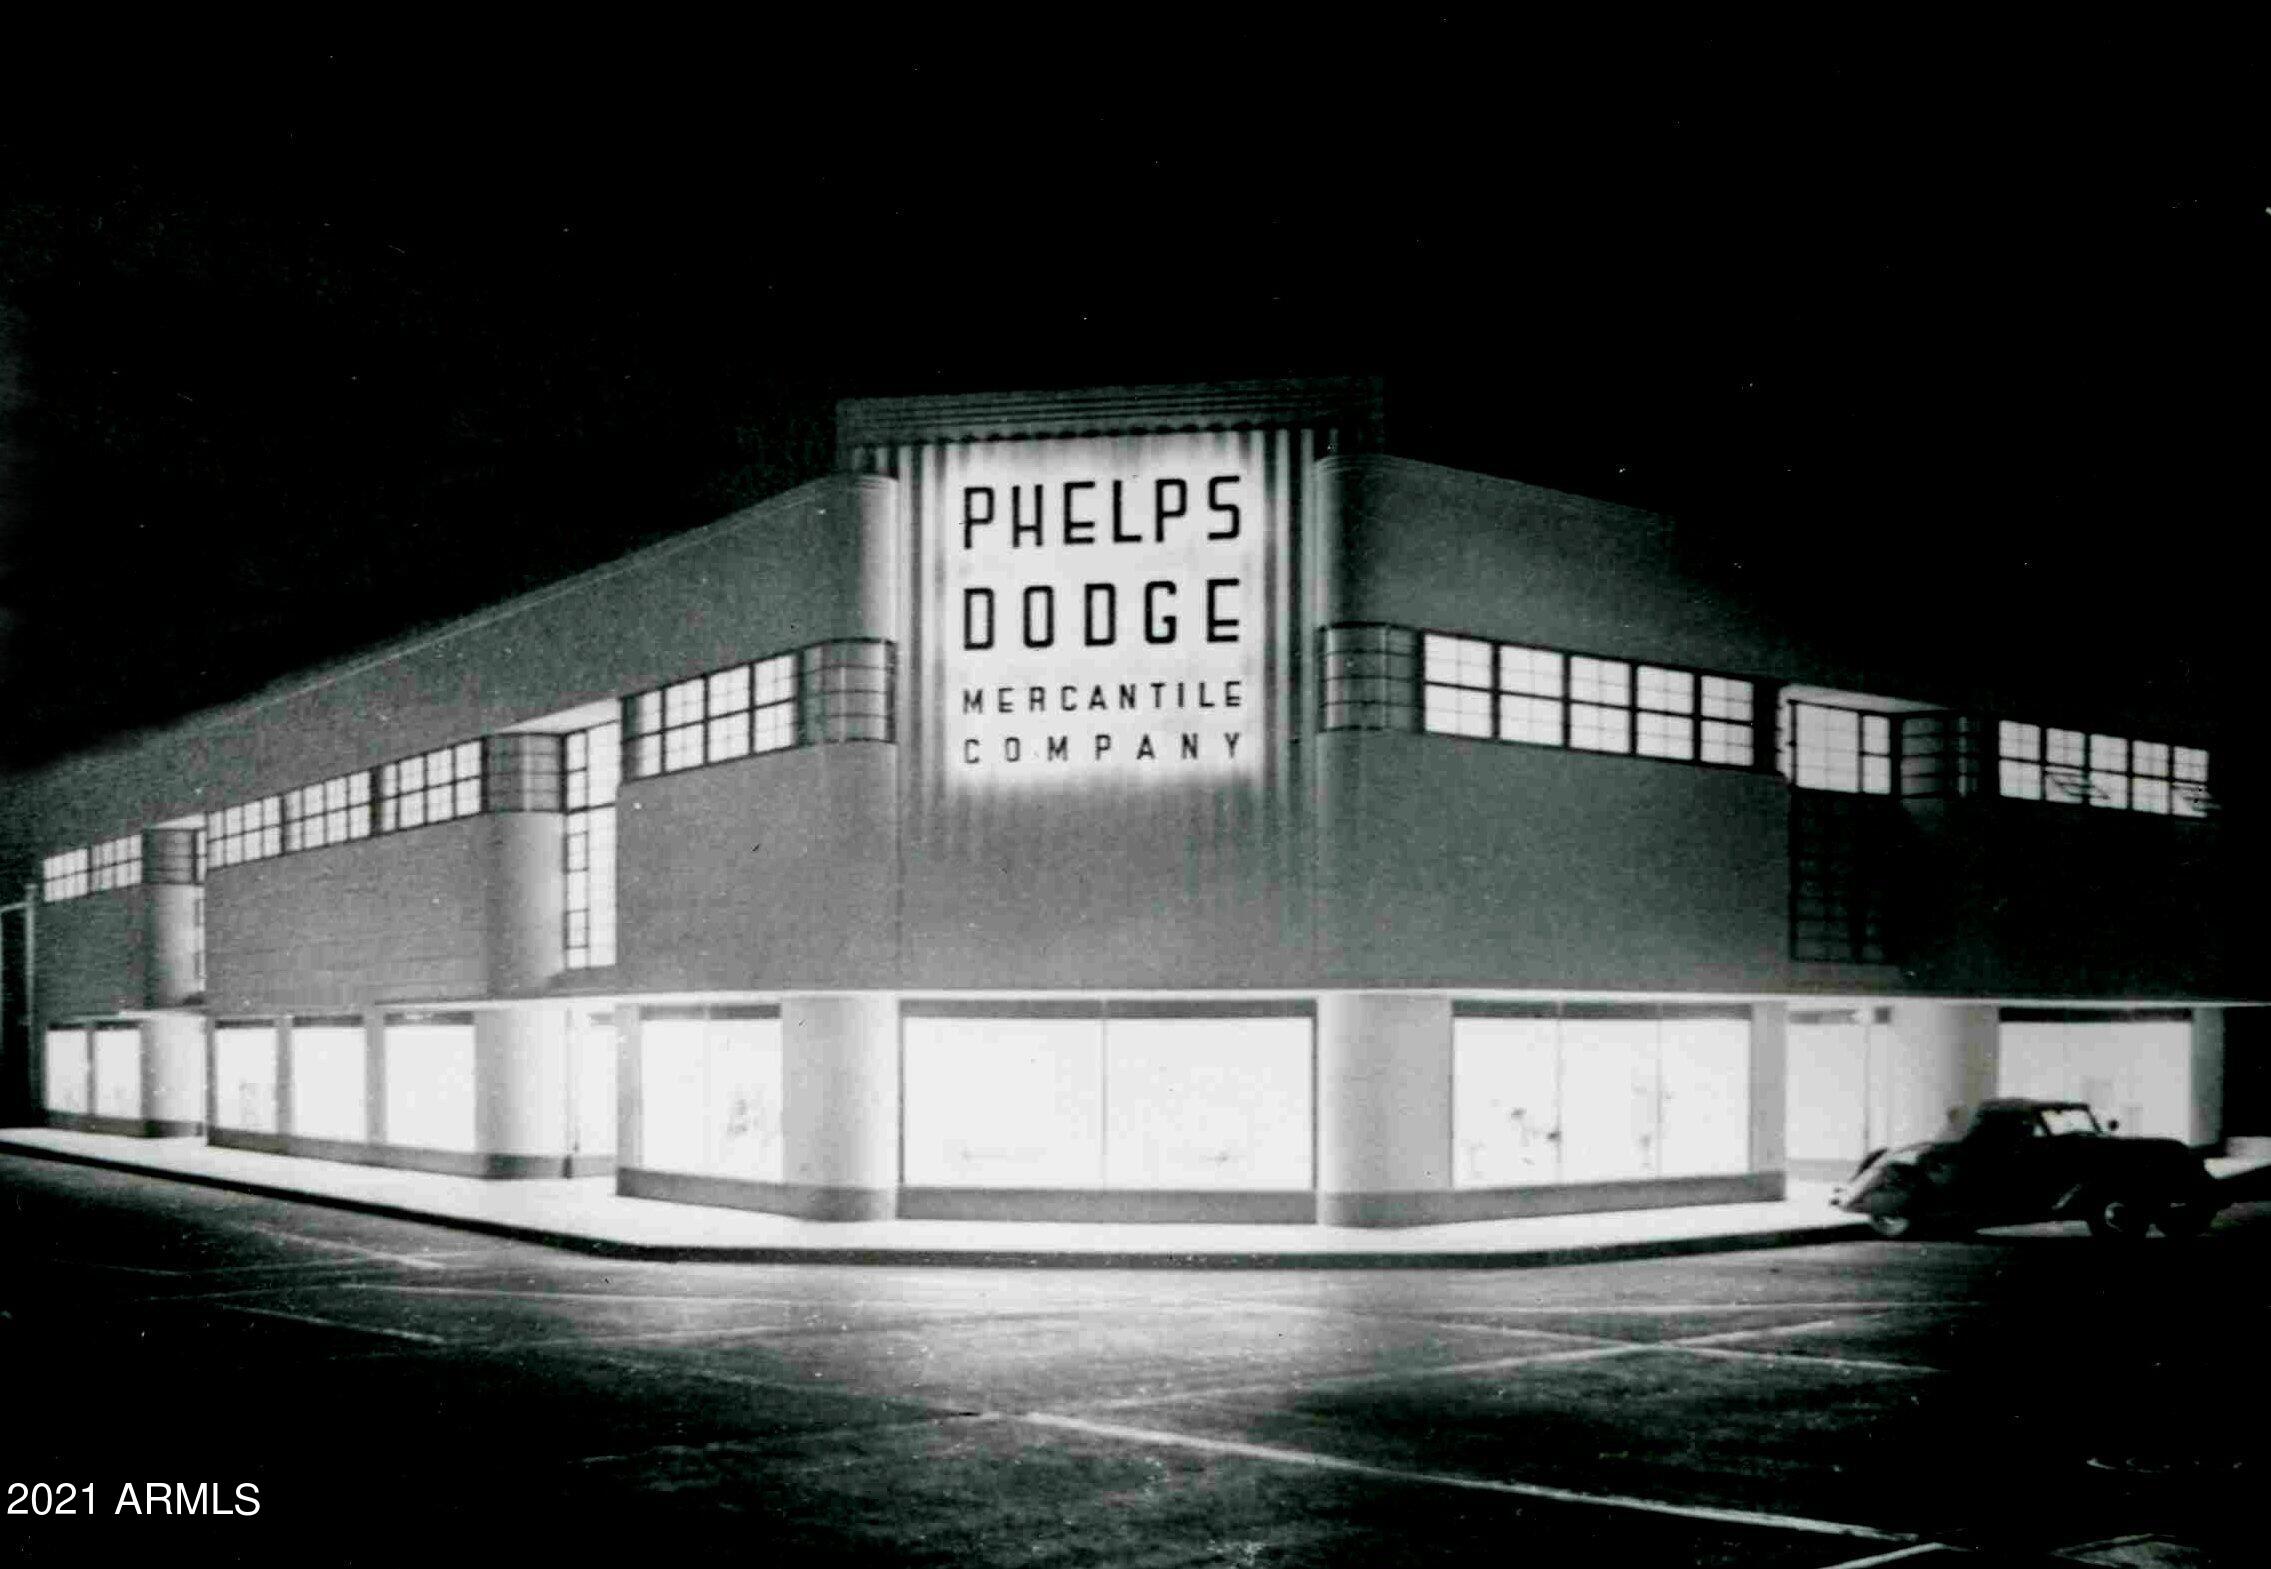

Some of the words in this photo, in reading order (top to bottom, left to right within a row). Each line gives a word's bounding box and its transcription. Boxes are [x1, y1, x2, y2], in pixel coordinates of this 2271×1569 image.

[964, 475, 1240, 549] PHELPS
[964, 578, 1240, 650] DODGE
[963, 681, 1241, 715] MERCANTILE
[963, 732, 1241, 764] COMPANY
